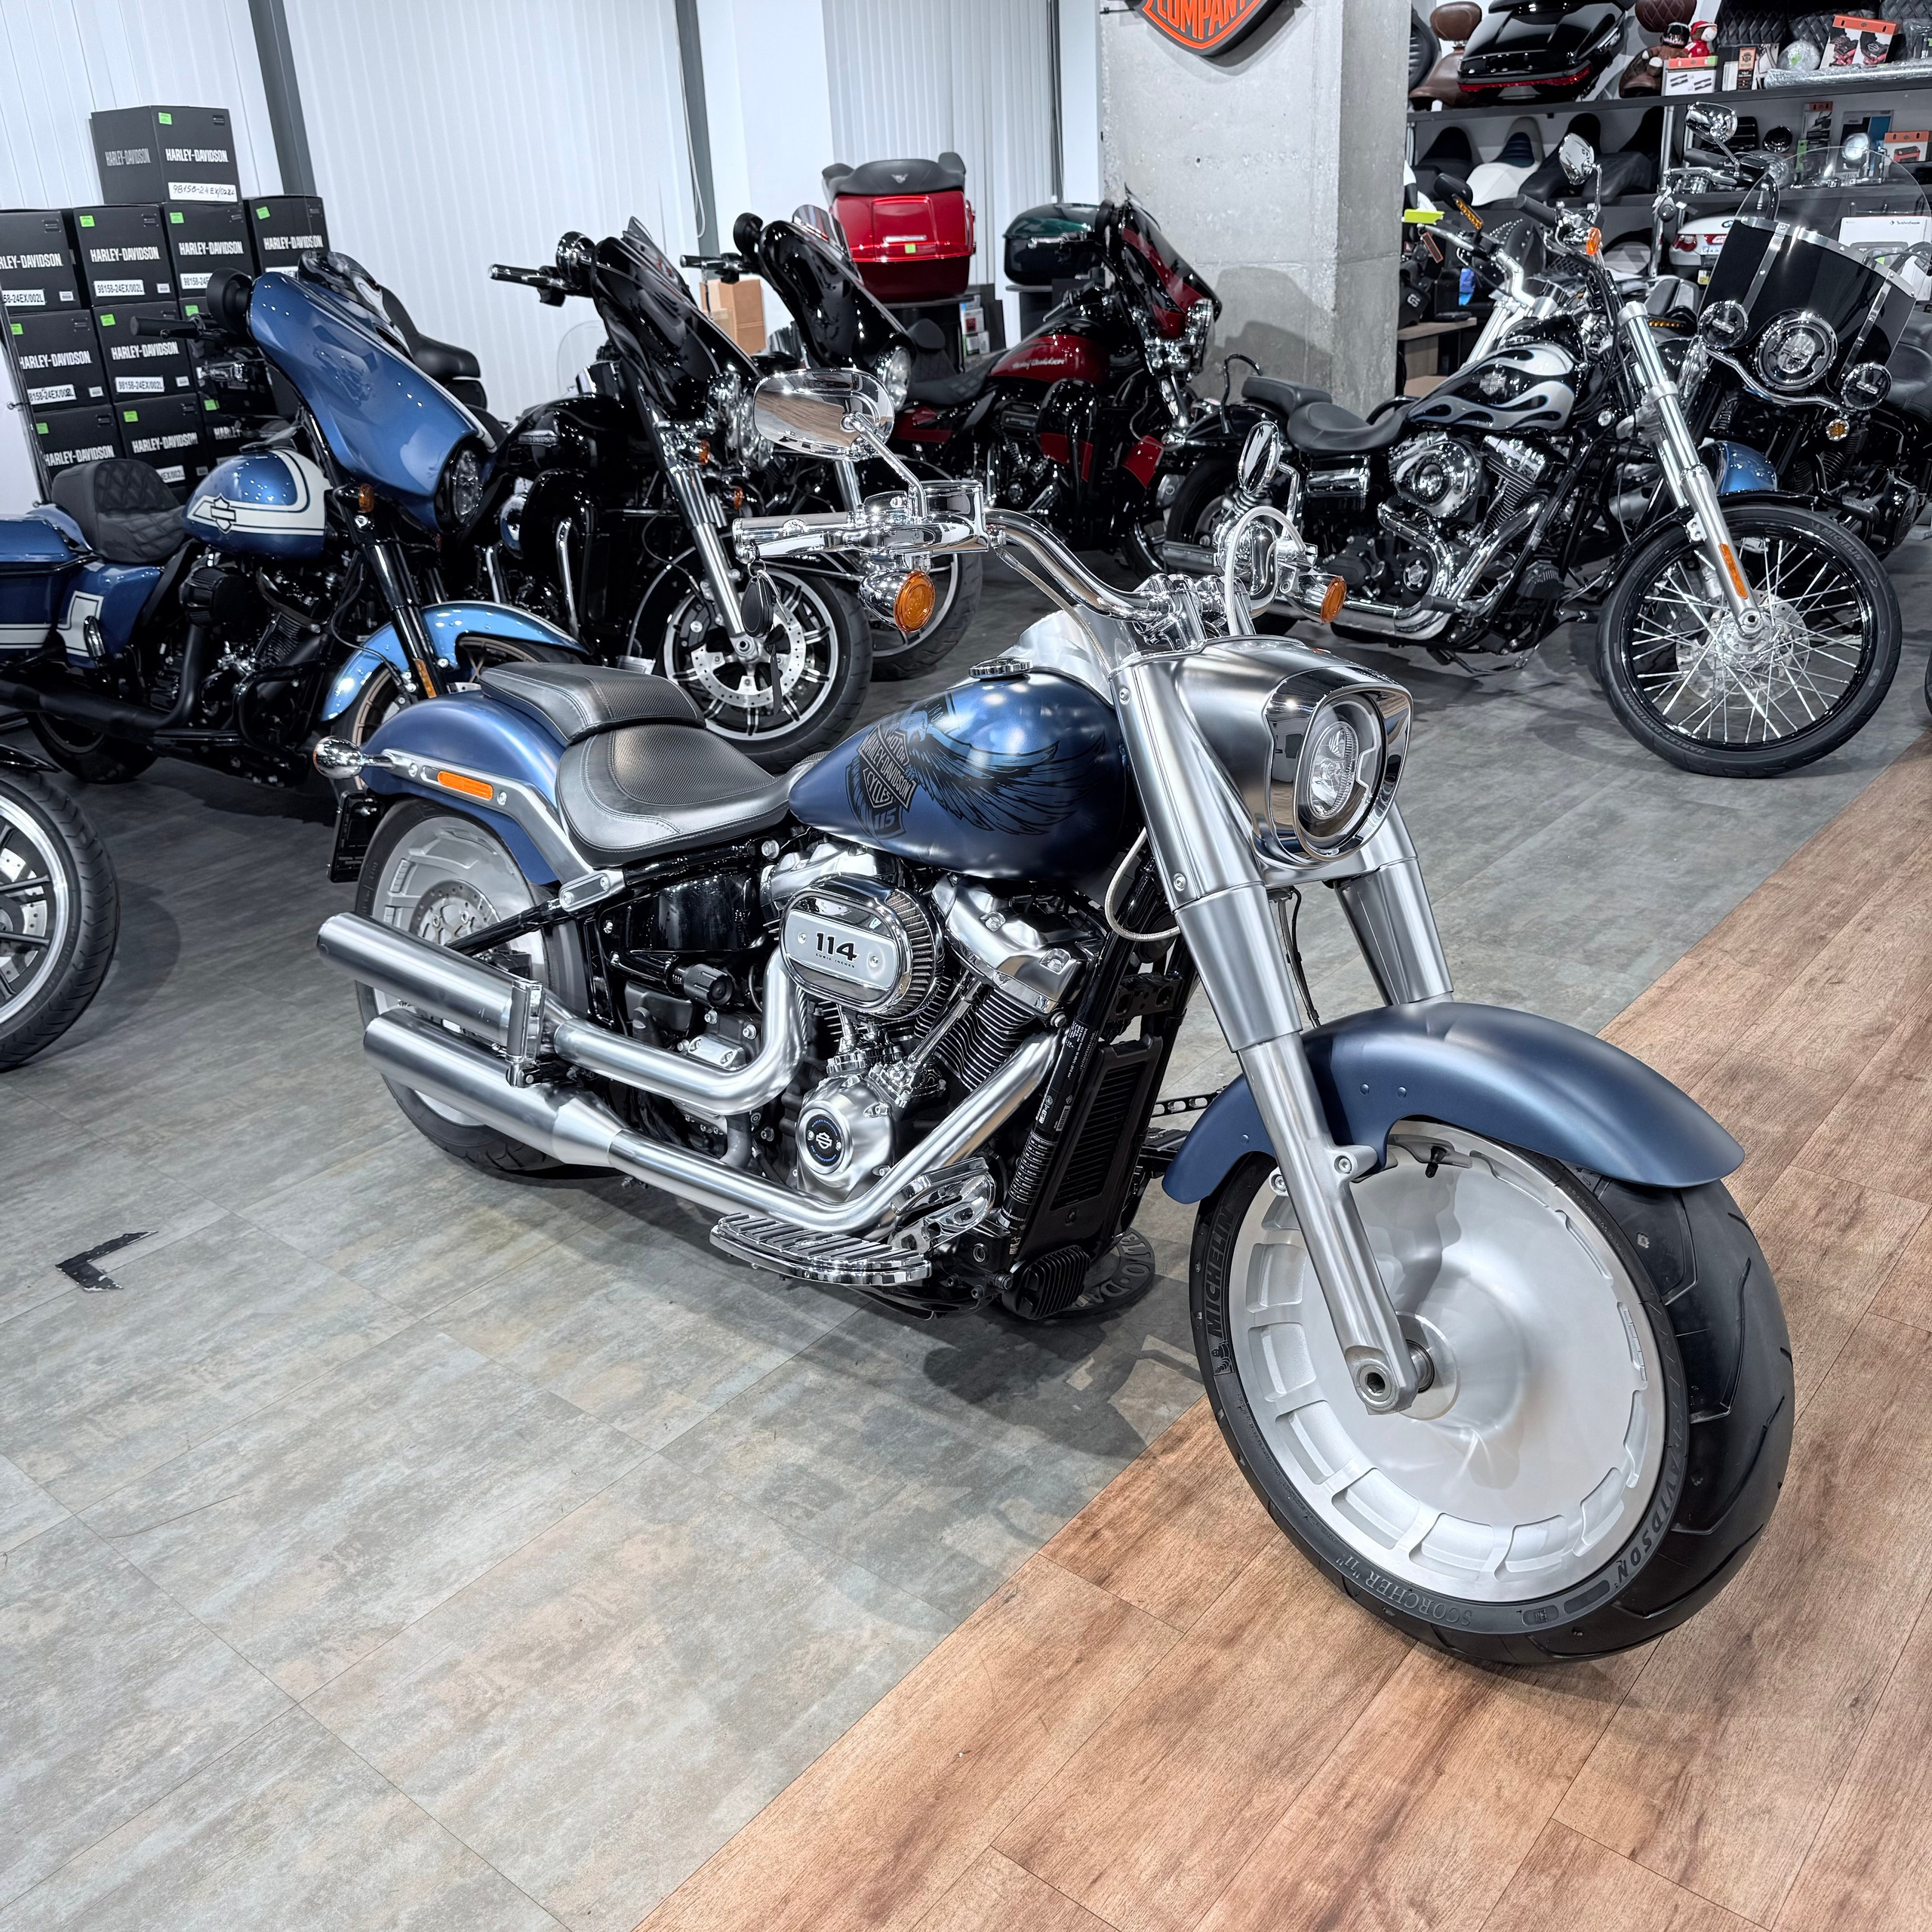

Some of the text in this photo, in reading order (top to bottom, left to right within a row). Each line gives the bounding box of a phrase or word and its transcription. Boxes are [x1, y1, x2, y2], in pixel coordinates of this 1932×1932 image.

[105, 149, 151, 167] HARLEY-DAVIDSON
[165, 149, 229, 162] HARLEY-DAVIDSON
[178, 242, 244, 255] HARLEY-DAVIDSON
[263, 235, 324, 250] HARLEY-DAVIDSON
[0, 253, 63, 269] RLEY-DAVIDSON
[90, 247, 161, 263] HARLEY-DAVIDSON
[183, 276, 209, 286] 98158-24E
[3, 294, 44, 303] 58-24EX/002L
[19, 350, 92, 370] HARLEY-DAVIDSON
[111, 342, 180, 360] HARLEY-DAVIDSON
[29, 387, 74, 401] 8158-24EX/002L
[131, 432, 198, 454] HARLEY-DAVIDSON
[1821, 528, 1863, 561] MICHELIN
[1624, 692, 1706, 755] HARLEY-DAVIDSON
[885, 733, 906, 764] MOTOR
[861, 732, 912, 801] HARLEY-DAVIDSON
[867, 771, 891, 804] CYCLES
[874, 807, 897, 829] 115
[817, 933, 859, 961] 114
[1204, 1207, 1235, 1339] MICHELIN
[1364, 1570, 1472, 1627] SCORCHER
